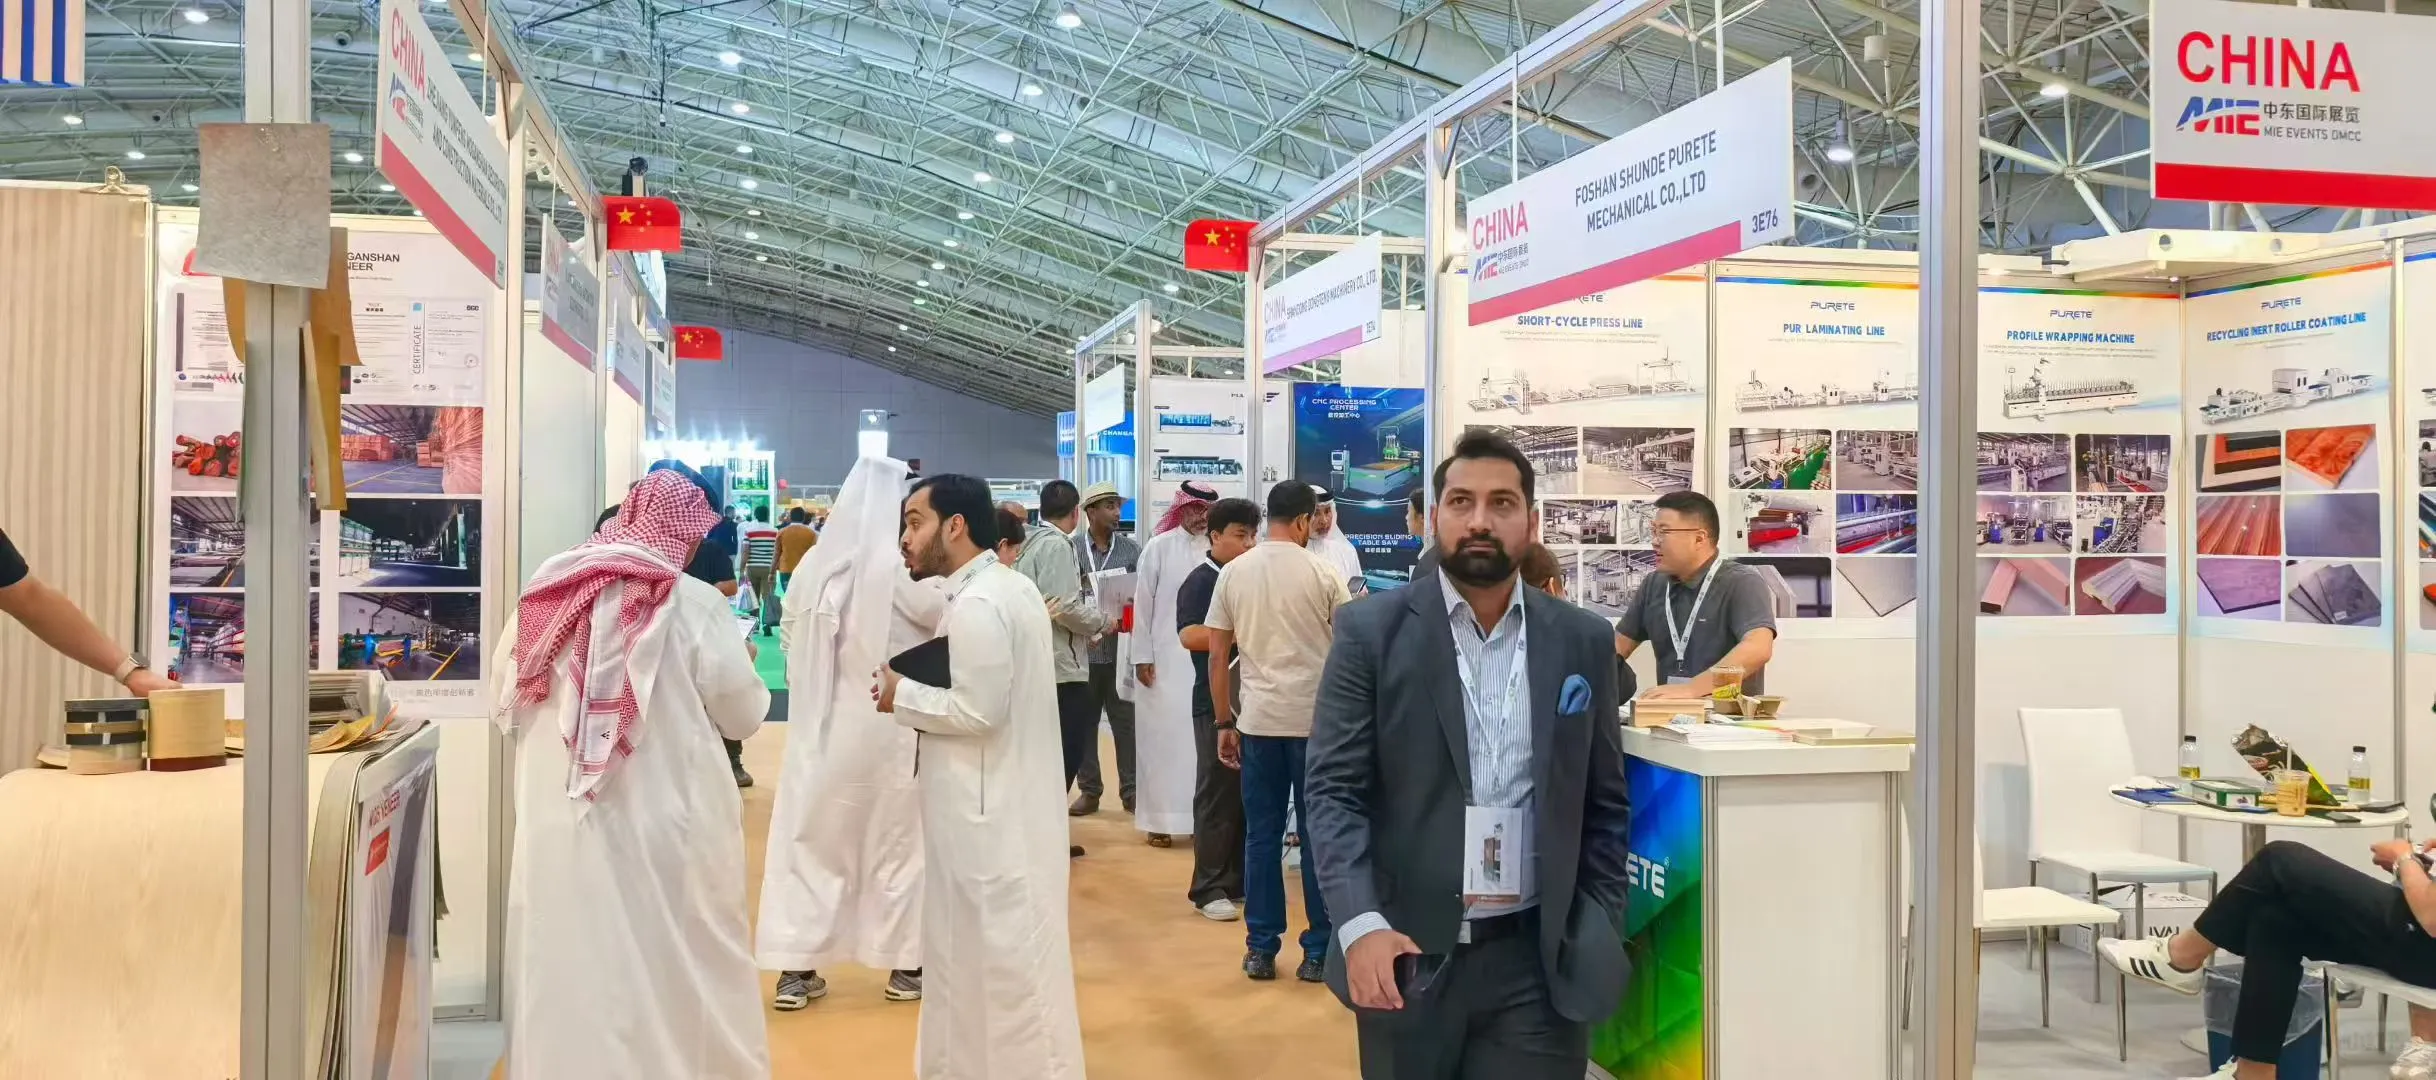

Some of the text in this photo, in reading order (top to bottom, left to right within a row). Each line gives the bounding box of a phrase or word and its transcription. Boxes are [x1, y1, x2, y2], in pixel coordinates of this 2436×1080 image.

[392, 8, 426, 101] CHINA
[2177, 31, 2361, 92] CHINA
[2176, 96, 2260, 136] MIE
[2263, 101, 2361, 124] 中东国际展览
[2264, 126, 2362, 141] MIE EVENTS DMCC
[1575, 130, 1717, 207] FOSHAN SHUNDE PURETE
[1473, 201, 1528, 250] CHINA
[1587, 191, 1658, 233] MECHANICAL
[1752, 208, 1778, 233] 3E76
[1264, 295, 1286, 324] CHINA
[1810, 301, 1855, 311] PURETE
[2050, 309, 2093, 320] PURETE
[2261, 297, 2302, 310] PURETE
[1517, 315, 1643, 328] SHORT-CYCLE PRESS LINE
[1783, 323, 1885, 336] PUR LAMINATING LINE
[2206, 312, 2367, 341] RECYCLING INERT ROLLER COATING LINE
[412, 325, 422, 375] CERTIFICATE
[2007, 330, 2135, 344] PROFILE WRAPPING MACHINE
